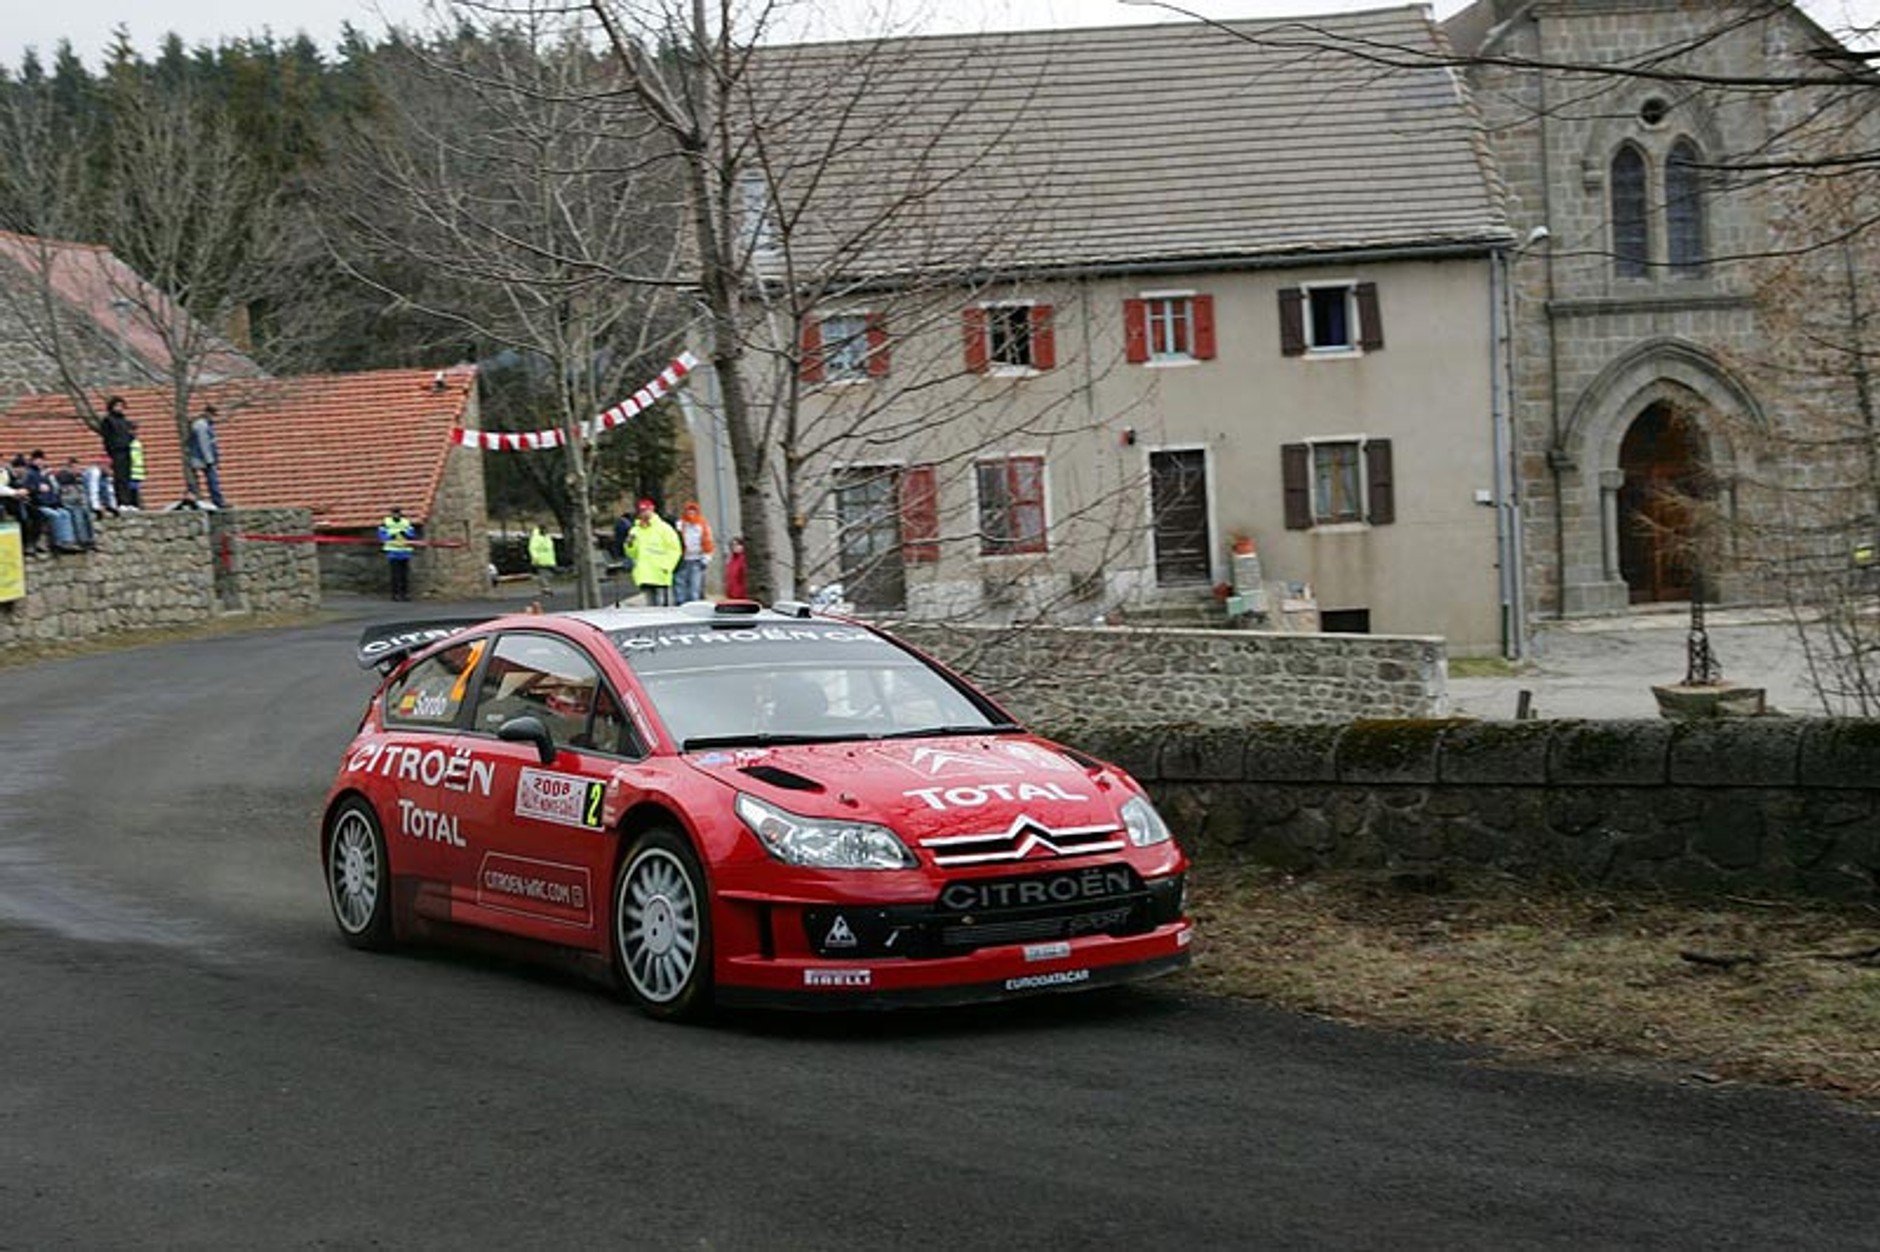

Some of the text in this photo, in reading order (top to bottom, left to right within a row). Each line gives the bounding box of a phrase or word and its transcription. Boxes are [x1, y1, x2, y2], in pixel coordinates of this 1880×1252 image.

[347, 743, 496, 797] CITROËN
[533, 777, 572, 797] 2008
[586, 782, 603, 828] 2
[903, 782, 1090, 812] TOTAL
[942, 868, 1130, 909] CITROËN
[1005, 969, 1091, 990] EURODATACAR
